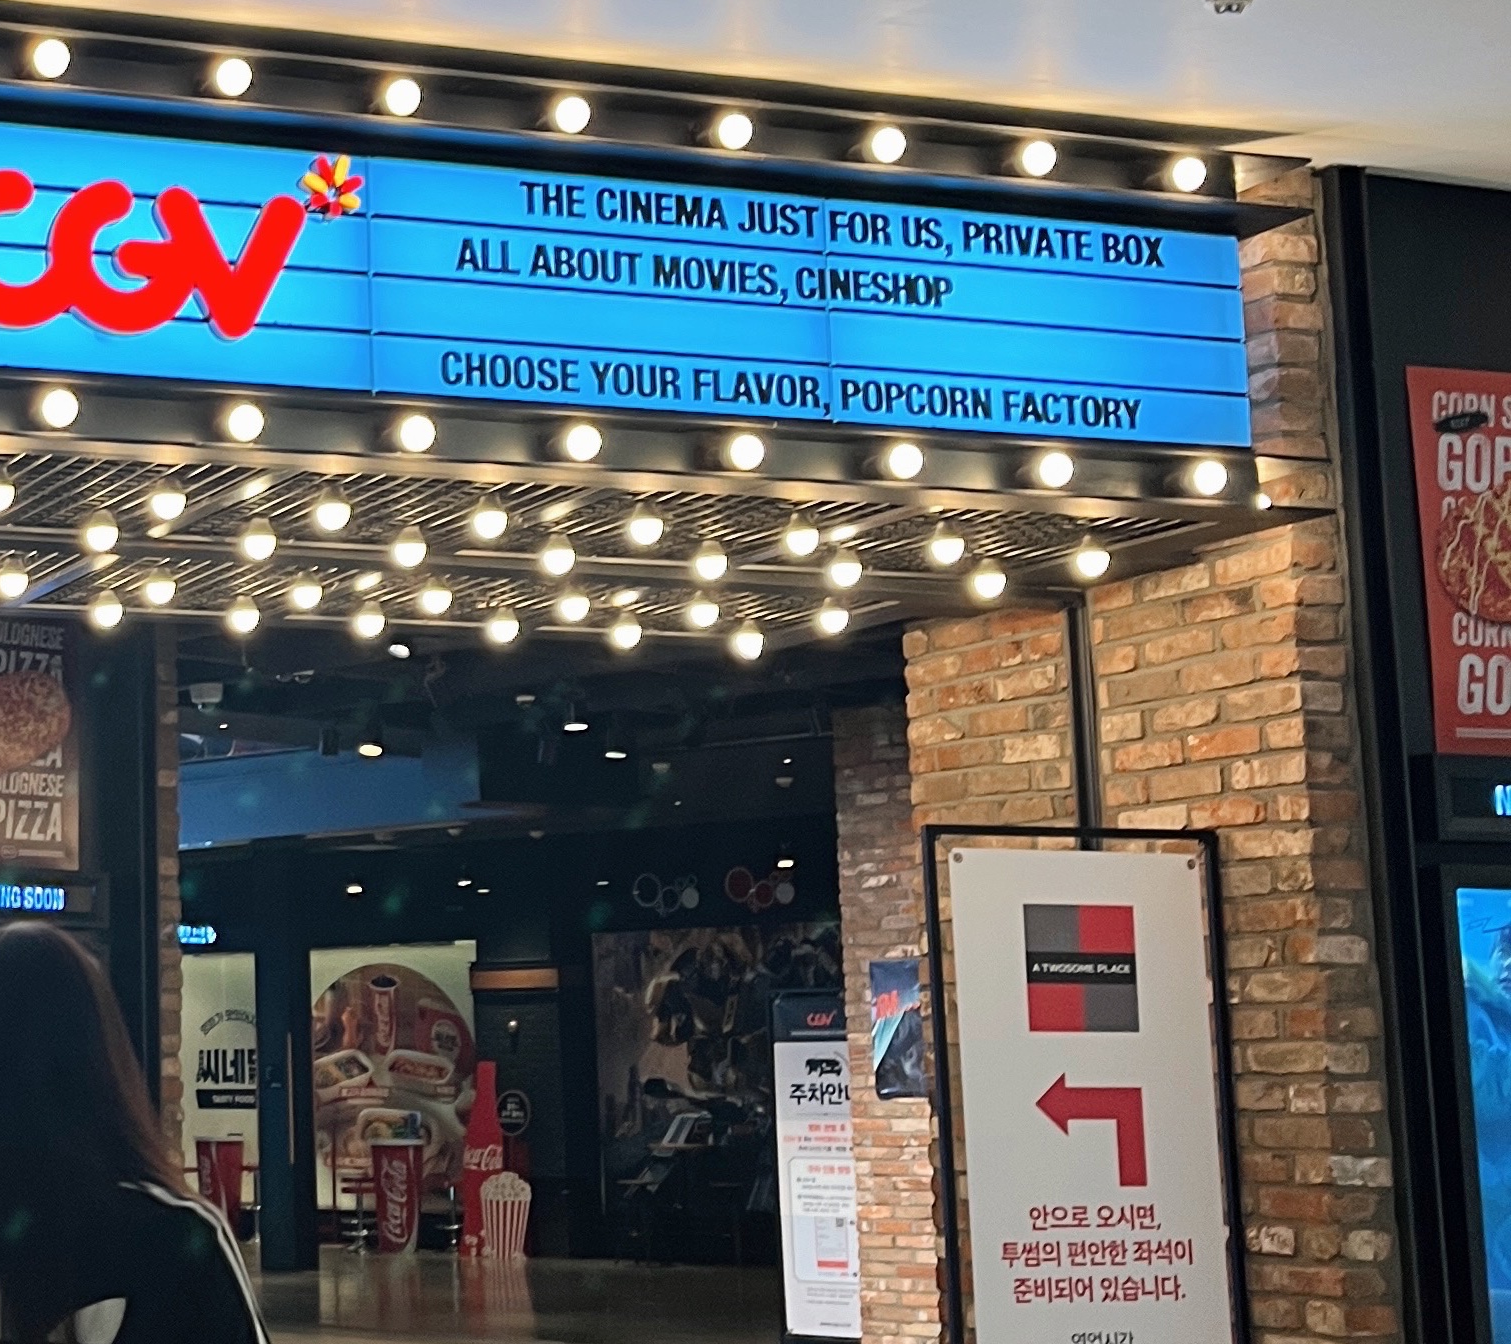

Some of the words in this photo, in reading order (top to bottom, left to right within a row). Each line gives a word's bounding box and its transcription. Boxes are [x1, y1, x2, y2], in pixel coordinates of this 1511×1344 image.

[519, 180, 587, 220] THE
[595, 186, 729, 232] CINEMA
[738, 200, 820, 239] JUST
[829, 208, 892, 246] FOR
[901, 215, 954, 257] US,
[962, 220, 1095, 263] PRIVATE
[1101, 233, 1165, 268] BOX
[455, 237, 520, 276] ALL
[528, 242, 644, 286] ABOUT
[652, 254, 790, 305] MOVIES,
[794, 265, 954, 309] CINESHOP
[440, 350, 581, 394] CHOOSE
[590, 359, 682, 401] YOUR
[692, 367, 832, 418] FLAVOR,
[840, 377, 993, 421] POPCORN
[1002, 388, 1142, 431] FACTORY
[22, 886, 66, 912] SOON
[1032, 962, 1041, 973] A
[1041, 962, 1095, 974] TWOSOME
[1096, 963, 1131, 974] PLACE
[1028, 1203, 1091, 1232] 안으로
[1095, 1203, 1162, 1231] 오시면,
[1000, 1240, 1062, 1269] 투썸의
[1067, 1239, 1128, 1267] 편안한
[1132, 1238, 1194, 1266] 좌석이
[1012, 1276, 1095, 1304] 준비되어
[1100, 1274, 1187, 1303] 있습니다.
